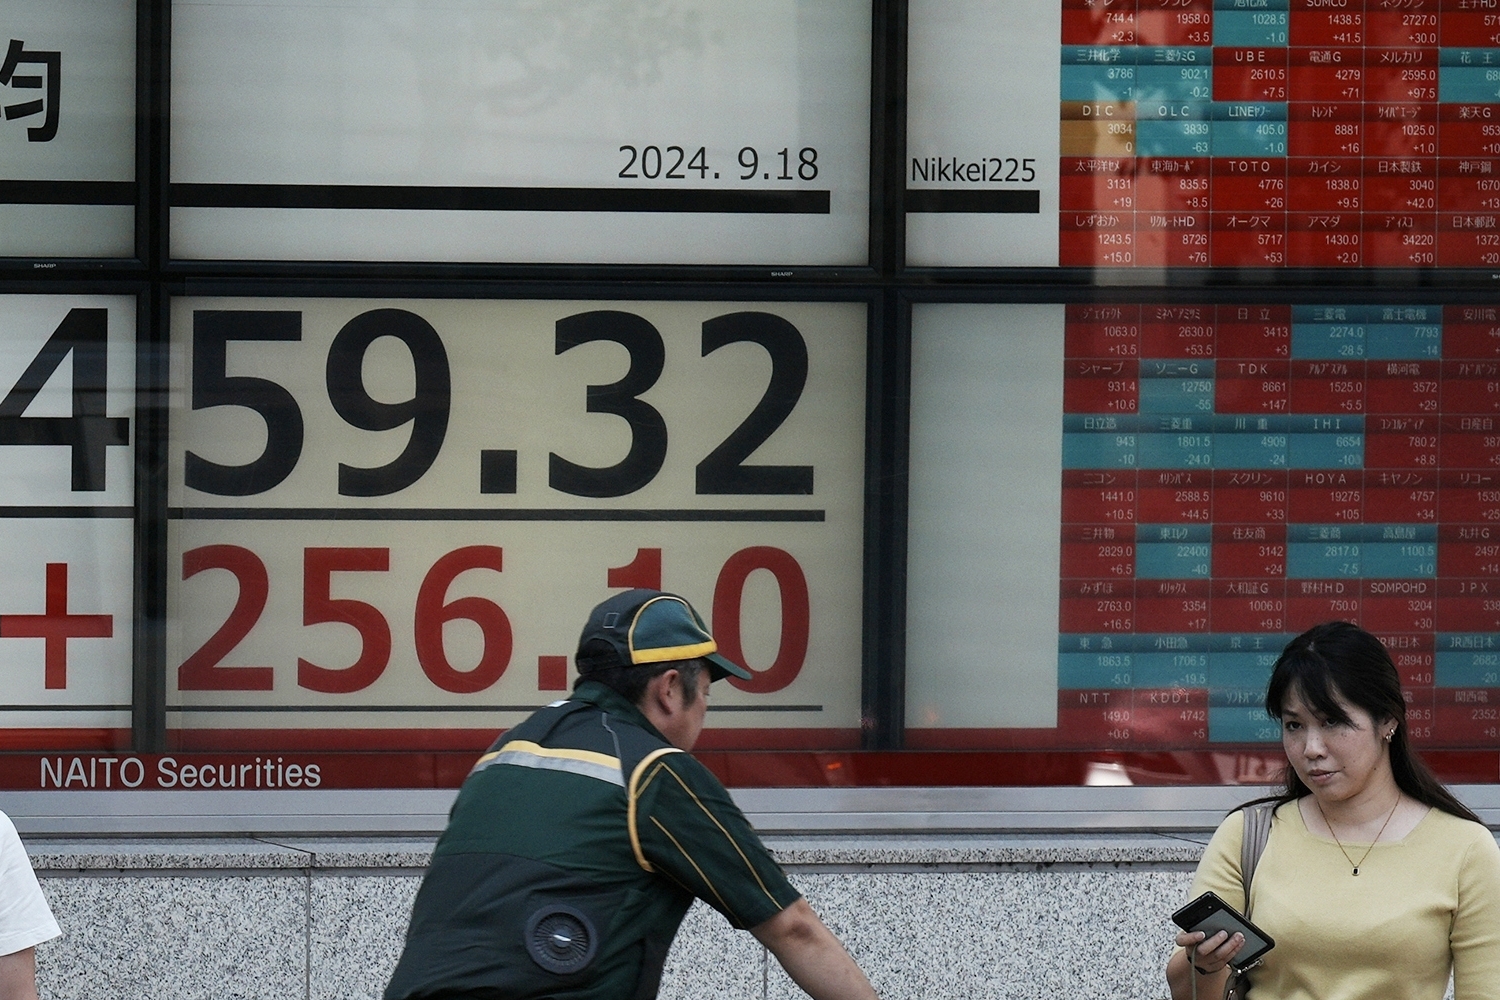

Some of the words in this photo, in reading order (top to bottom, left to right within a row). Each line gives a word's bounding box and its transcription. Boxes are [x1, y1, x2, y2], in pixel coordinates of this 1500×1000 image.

[1107, 13, 1134, 23] 744.4
[1177, 14, 1210, 24] 1958.0
[1253, 15, 1285, 25] 1028.5
[1329, 15, 1361, 25] 1438.5
[1403, 15, 1436, 25] 2727.0
[1111, 32, 1134, 41] +2.3
[1188, 33, 1210, 41] +3.5
[1266, 33, 1285, 42] -1.0
[1333, 34, 1361, 43] +41.5
[1409, 34, 1436, 43] +30.0
[1077, 50, 1120, 61] 三井化学
[1309, 51, 1341, 63] 電通G
[1380, 52, 1423, 63] メルカリ
[1108, 69, 1133, 79] 3786
[1181, 70, 1208, 79] 902.1
[1251, 70, 1285, 79] 2610.5
[1336, 70, 1360, 80] 4279
[1402, 70, 1435, 80] 2595.0
[1123, 88, 1132, 96] -1
[1190, 88, 1208, 97] -0.2
[1263, 89, 1285, 97] +7.5
[1342, 89, 1359, 98] +71
[1408, 89, 1435, 98] +97.5
[1460, 107, 1491, 118] 楽天G
[1108, 124, 1132, 134] 3034
[1184, 125, 1208, 134] 3839
[1256, 125, 1284, 135] 405.0
[1335, 125, 1359, 135] 8881
[1402, 125, 1435, 135] 1025.0
[1126, 143, 1132, 152] 0
[1192, 143, 1208, 152] -63
[1265, 143, 1284, 152] -1.0
[1341, 143, 1359, 153] +16
[1413, 144, 1434, 153] +1.0
[738, 146, 820, 181] 9.18
[1308, 161, 1341, 173] ガイシ
[1378, 161, 1422, 172] 日本製鉄
[911, 156, 1037, 184] Nikkei225
[1108, 179, 1131, 189] 3131
[1180, 180, 1208, 189] 835.5
[1258, 180, 1283, 189] 4776
[1326, 180, 1359, 190] 1838.0
[1410, 180, 1434, 190] 3040
[1114, 198, 1132, 207] +19
[1186, 198, 1208, 207] +8.5
[1265, 198, 1283, 207] +26
[1337, 198, 1358, 208] +9.5
[1406, 198, 1434, 208] +42.0
[1076, 216, 1119, 226] しずおか
[1227, 216, 1270, 227] オークマ
[1308, 216, 1340, 227] アマダ
[1452, 217, 1496, 227] 日本郵政
[1099, 235, 1131, 244] 1243.5
[1182, 235, 1207, 244] 8726
[1258, 235, 1282, 244] 5717
[1325, 235, 1358, 245] 1430.0
[1403, 235, 1433, 245] 34220
[1104, 253, 1131, 262] +15.0
[1189, 253, 1207, 263] +76
[1264, 253, 1282, 262] +53
[1337, 253, 1358, 263] +2.0
[1409, 253, 1433, 263] +510
[1104, 327, 1137, 336] 1063.0
[1179, 327, 1212, 337] 2630.0
[1415, 327, 1438, 337] 7793
[1109, 345, 1137, 354] +13.5
[1185, 346, 1212, 355] +53.5
[1156, 363, 1198, 374] ソニーG
[1108, 382, 1135, 391] 931.4
[1182, 382, 1211, 391] 12750
[1330, 382, 1362, 392] 1525.0
[1413, 382, 1437, 392] 3572
[1108, 400, 1135, 409] +10.6
[1340, 401, 1362, 410] +5.5
[1419, 401, 1437, 410] +29
[1116, 437, 1134, 446] 943
[1178, 437, 1210, 446] 1801.5
[1336, 437, 1360, 446] 6654
[1409, 437, 1436, 446] 780.2
[1083, 473, 1116, 484] ニコン
[1101, 492, 1133, 501] 1441.0
[1176, 492, 1209, 501] 2588.5
[1331, 492, 1360, 501] 19275
[1410, 492, 1434, 501] 4757
[1106, 510, 1133, 519] +10.5
[1181, 510, 1208, 519] +44.5
[1335, 510, 1359, 519] +105
[1416, 510, 1434, 519] +34
[1080, 583, 1113, 594] みずほ
[1371, 583, 1426, 593] SOMPOHD
[1097, 602, 1131, 611] 2763.0
[1182, 602, 1206, 611] 3354
[1408, 601, 1432, 610] 3204
[1104, 620, 1131, 629] +16.5
[1414, 620, 1432, 629] +30
[1103, 712, 1129, 721] 149.0
[1180, 712, 1205, 721] 4742
[40, 757, 145, 788] NAITO
[157, 757, 322, 788] Securities
